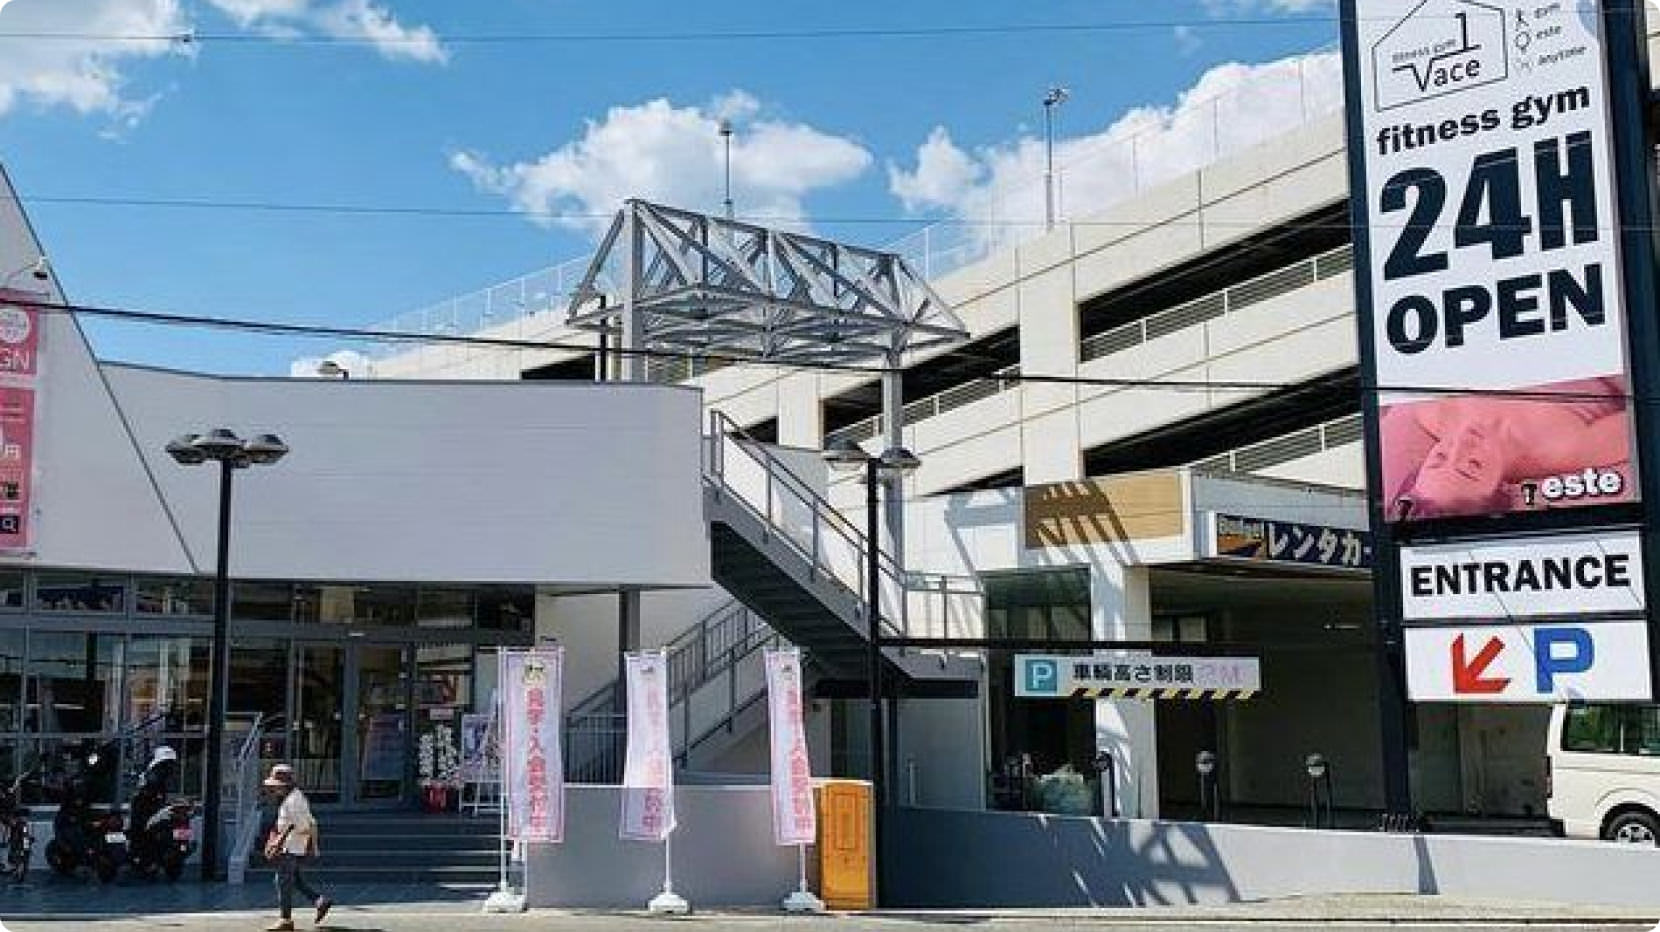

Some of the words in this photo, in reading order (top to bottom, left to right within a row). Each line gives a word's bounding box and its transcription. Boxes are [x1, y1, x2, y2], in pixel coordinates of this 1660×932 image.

[1377, 109, 1501, 154] fitness
[1511, 86, 1590, 129] gym
[1379, 130, 1599, 281] 24H
[1386, 262, 1606, 355] OPEN
[1541, 467, 1623, 500] este
[1411, 554, 1630, 597] ENTRANCE
[1032, 664, 1051, 688] P
[1534, 627, 1595, 694] P
